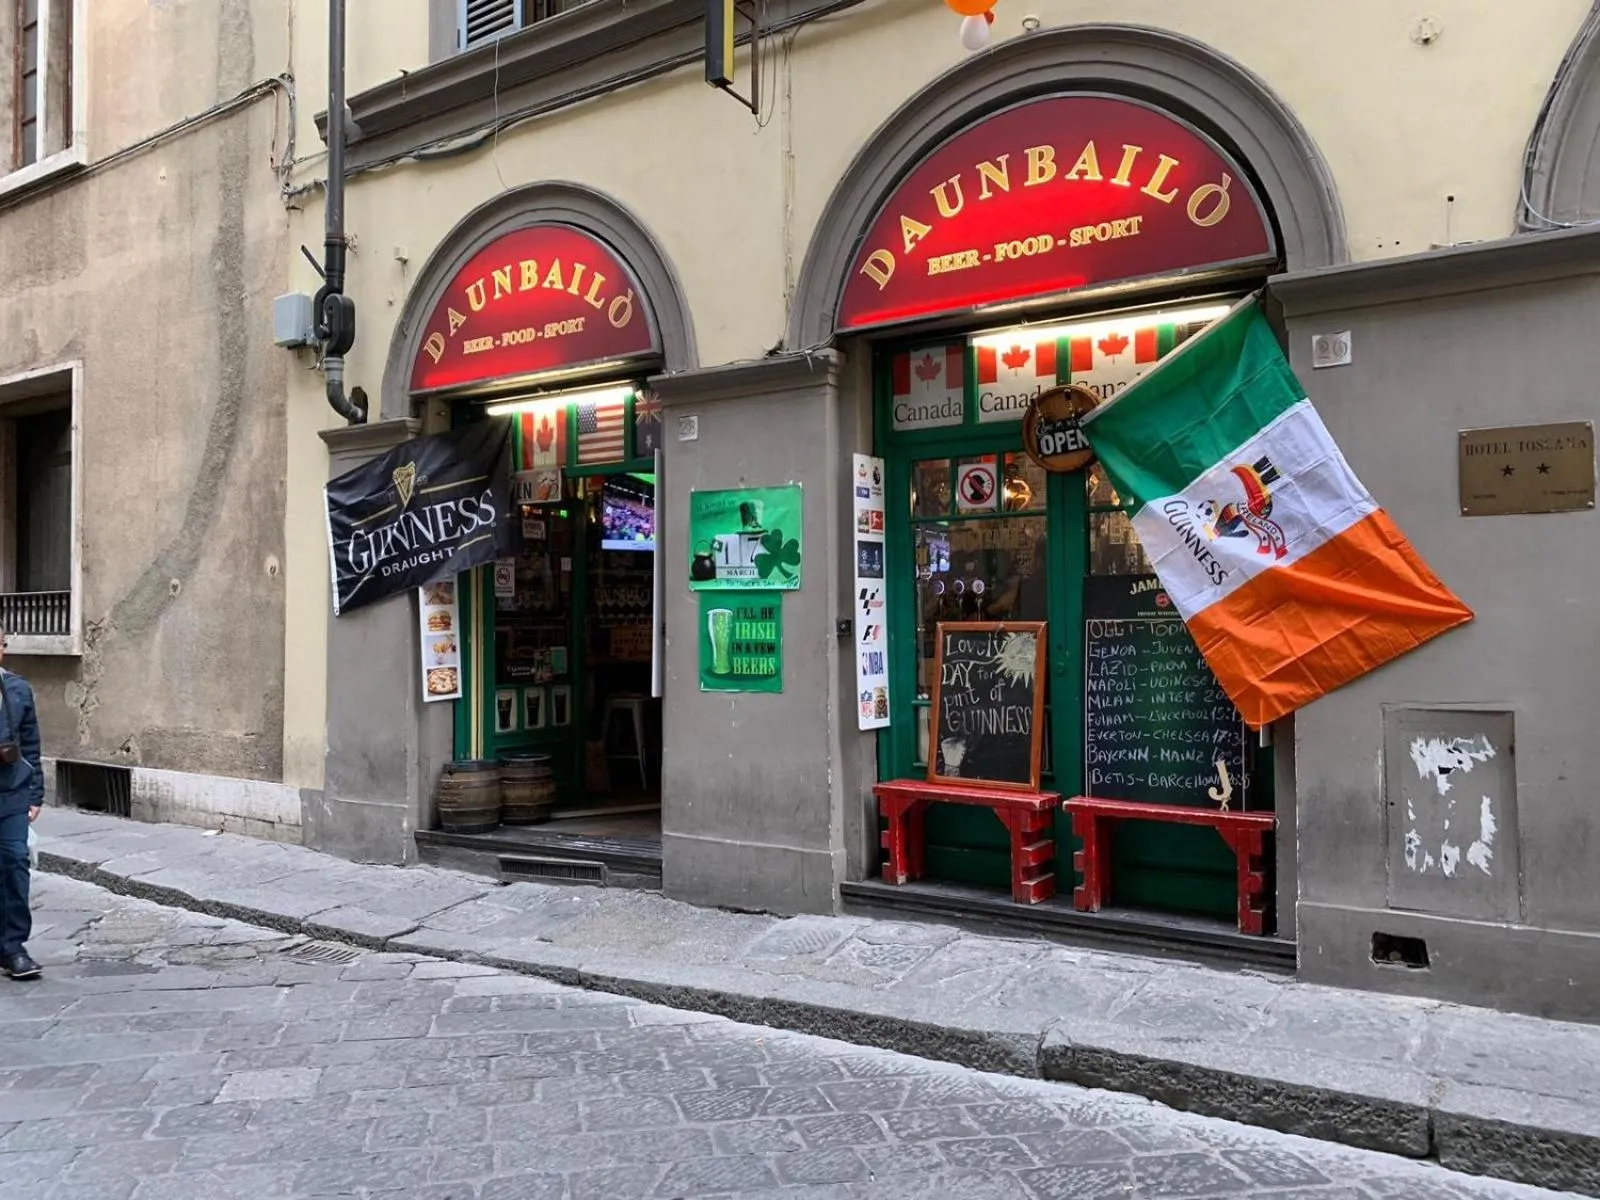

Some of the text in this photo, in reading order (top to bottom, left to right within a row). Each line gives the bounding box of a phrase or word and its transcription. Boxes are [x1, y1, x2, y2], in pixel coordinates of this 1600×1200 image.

[927, 247, 981, 276] BEER
[994, 234, 1054, 263] FOOD
[1069, 216, 1143, 248] SPORT
[463, 336, 494, 354] BEER
[501, 326, 536, 347] FOOD
[544, 316, 586, 339] SPORT
[895, 400, 964, 423] Canada
[1040, 429, 1090, 455] OPEN
[1465, 437, 1587, 456] HOTEL TOSCANA
[1238, 501, 1278, 534] IRELAND
[1163, 500, 1229, 585] GUINNESS
[381, 547, 455, 577] DRAUGHT
[735, 622, 776, 640] IRISH
[1089, 620, 1134, 639] OGGI
[1149, 621, 1187, 637] TODA
[733, 657, 776, 675] BEERS
[942, 662, 995, 687] DAY for
[1089, 660, 1138, 678] LAZIO
[944, 681, 1007, 719] pint of
[948, 705, 1033, 735] GUINNESS
[1088, 728, 1142, 743] EVERTON
[1152, 729, 1210, 743] CHELSEA
[1091, 768, 1135, 786] BETIS
